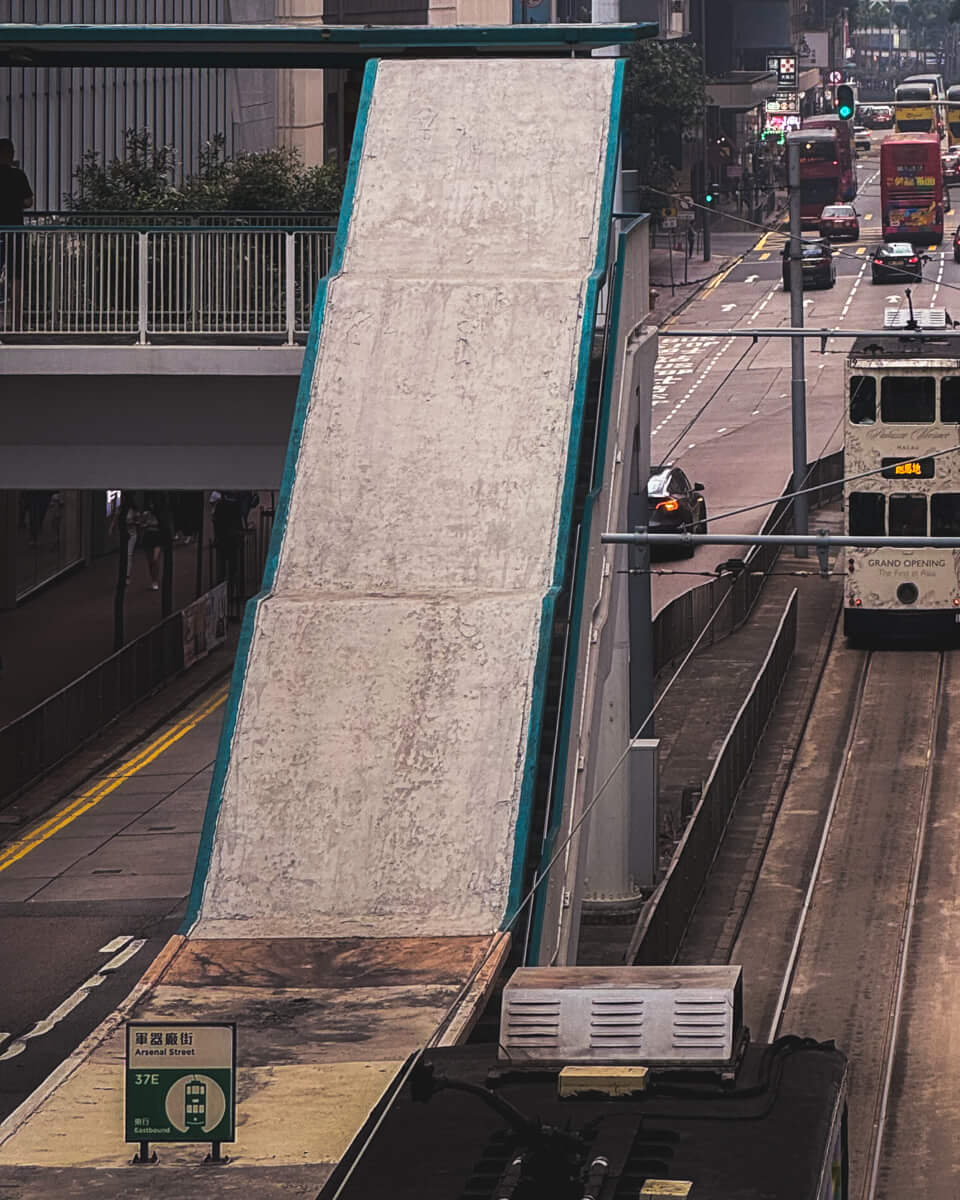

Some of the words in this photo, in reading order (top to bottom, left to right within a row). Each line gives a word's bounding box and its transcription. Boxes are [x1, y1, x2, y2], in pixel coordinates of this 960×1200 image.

[868, 559, 901, 568] GRAND
[903, 559, 946, 568] OPENING
[135, 1032, 193, 1046] 軍器廠街
[135, 1048, 167, 1056] Arsenal
[169, 1048, 195, 1056] Street
[135, 1073, 160, 1086] 37E
[134, 1126, 171, 1134] Eastbound
